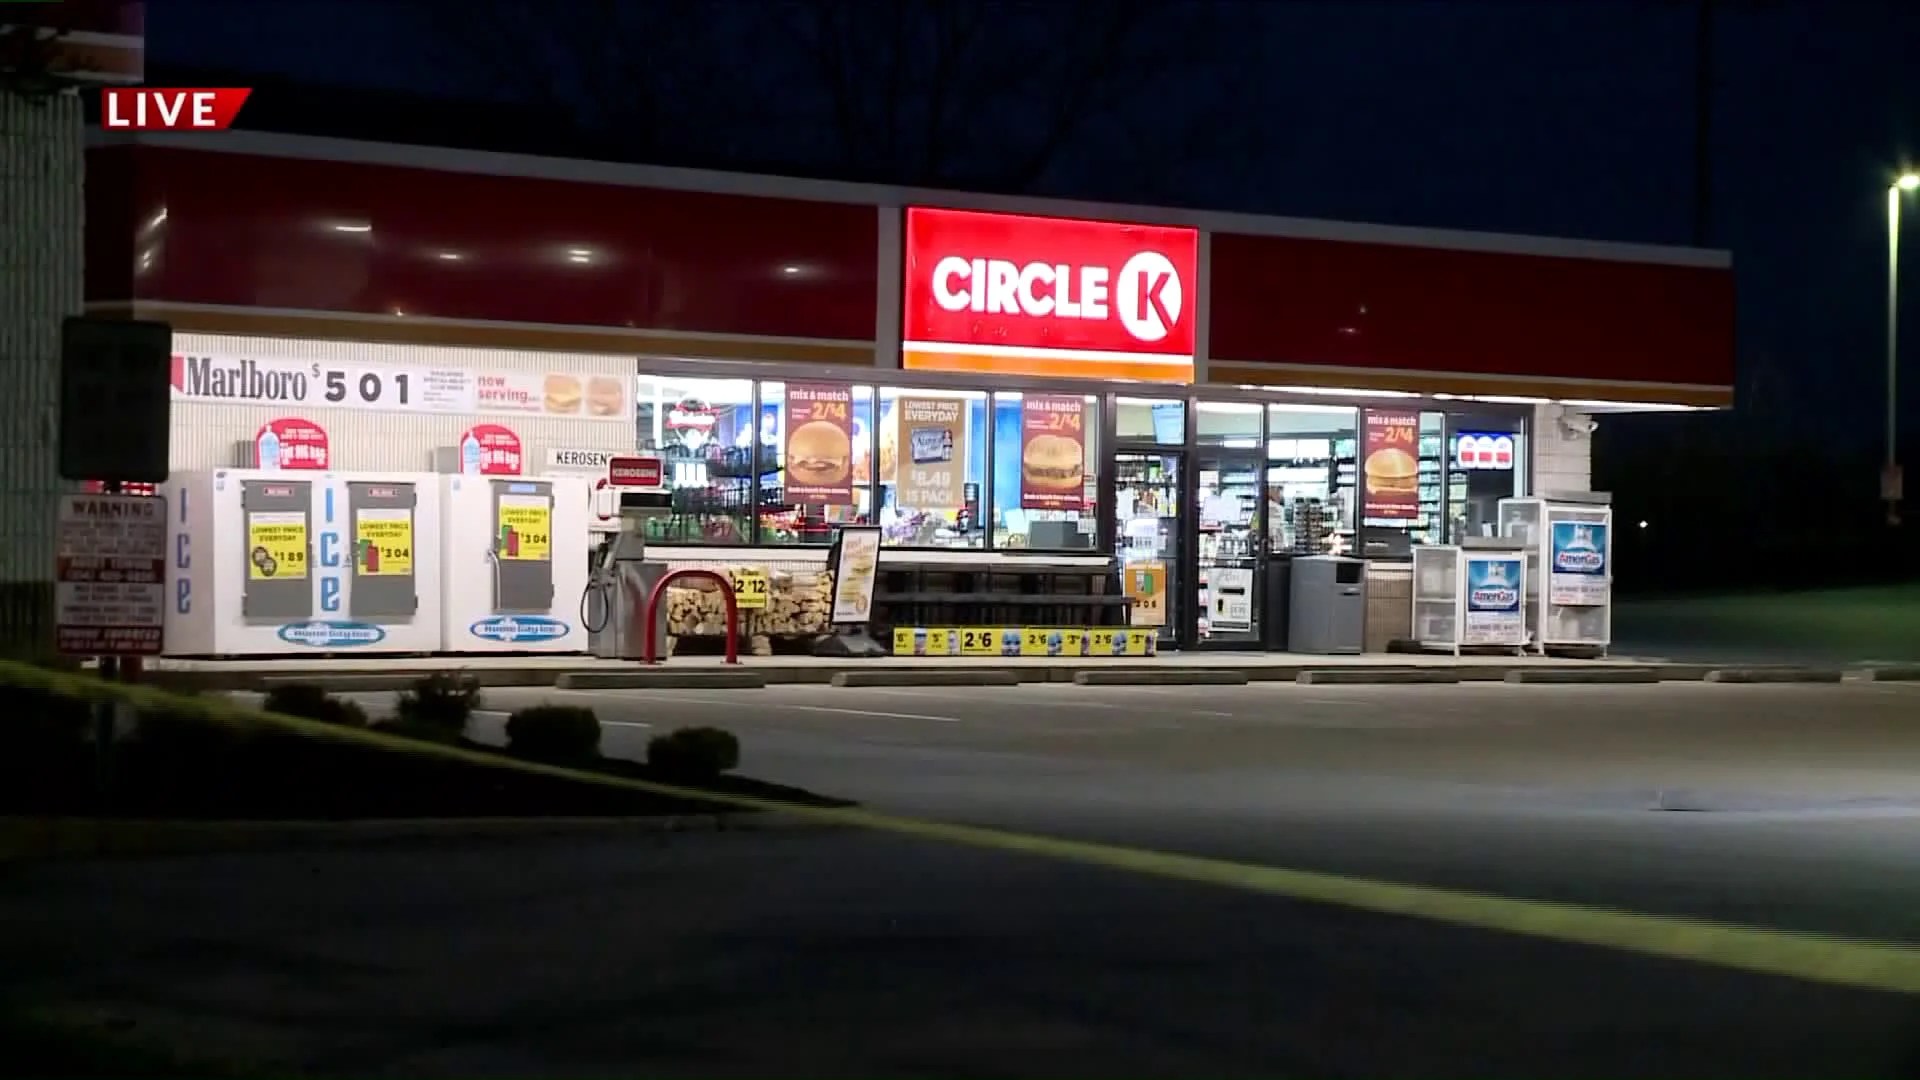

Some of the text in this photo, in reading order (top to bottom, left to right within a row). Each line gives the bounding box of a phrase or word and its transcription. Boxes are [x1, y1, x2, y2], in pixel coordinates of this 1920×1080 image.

[932, 256, 1109, 320] CIRCLE
[187, 357, 307, 400] Marlboro
[478, 376, 505, 387] now
[790, 389, 809, 401] mix
[817, 391, 849, 402] match
[903, 400, 935, 410] LOWEST
[1051, 400, 1081, 412] match
[903, 409, 960, 423] EVERYDAY
[72, 501, 154, 516] WARNING
[1559, 552, 1601, 566] AmeriGas
[1473, 591, 1515, 602] AmeriGas
[964, 632, 975, 648] 2
[1029, 634, 1036, 645] 2
